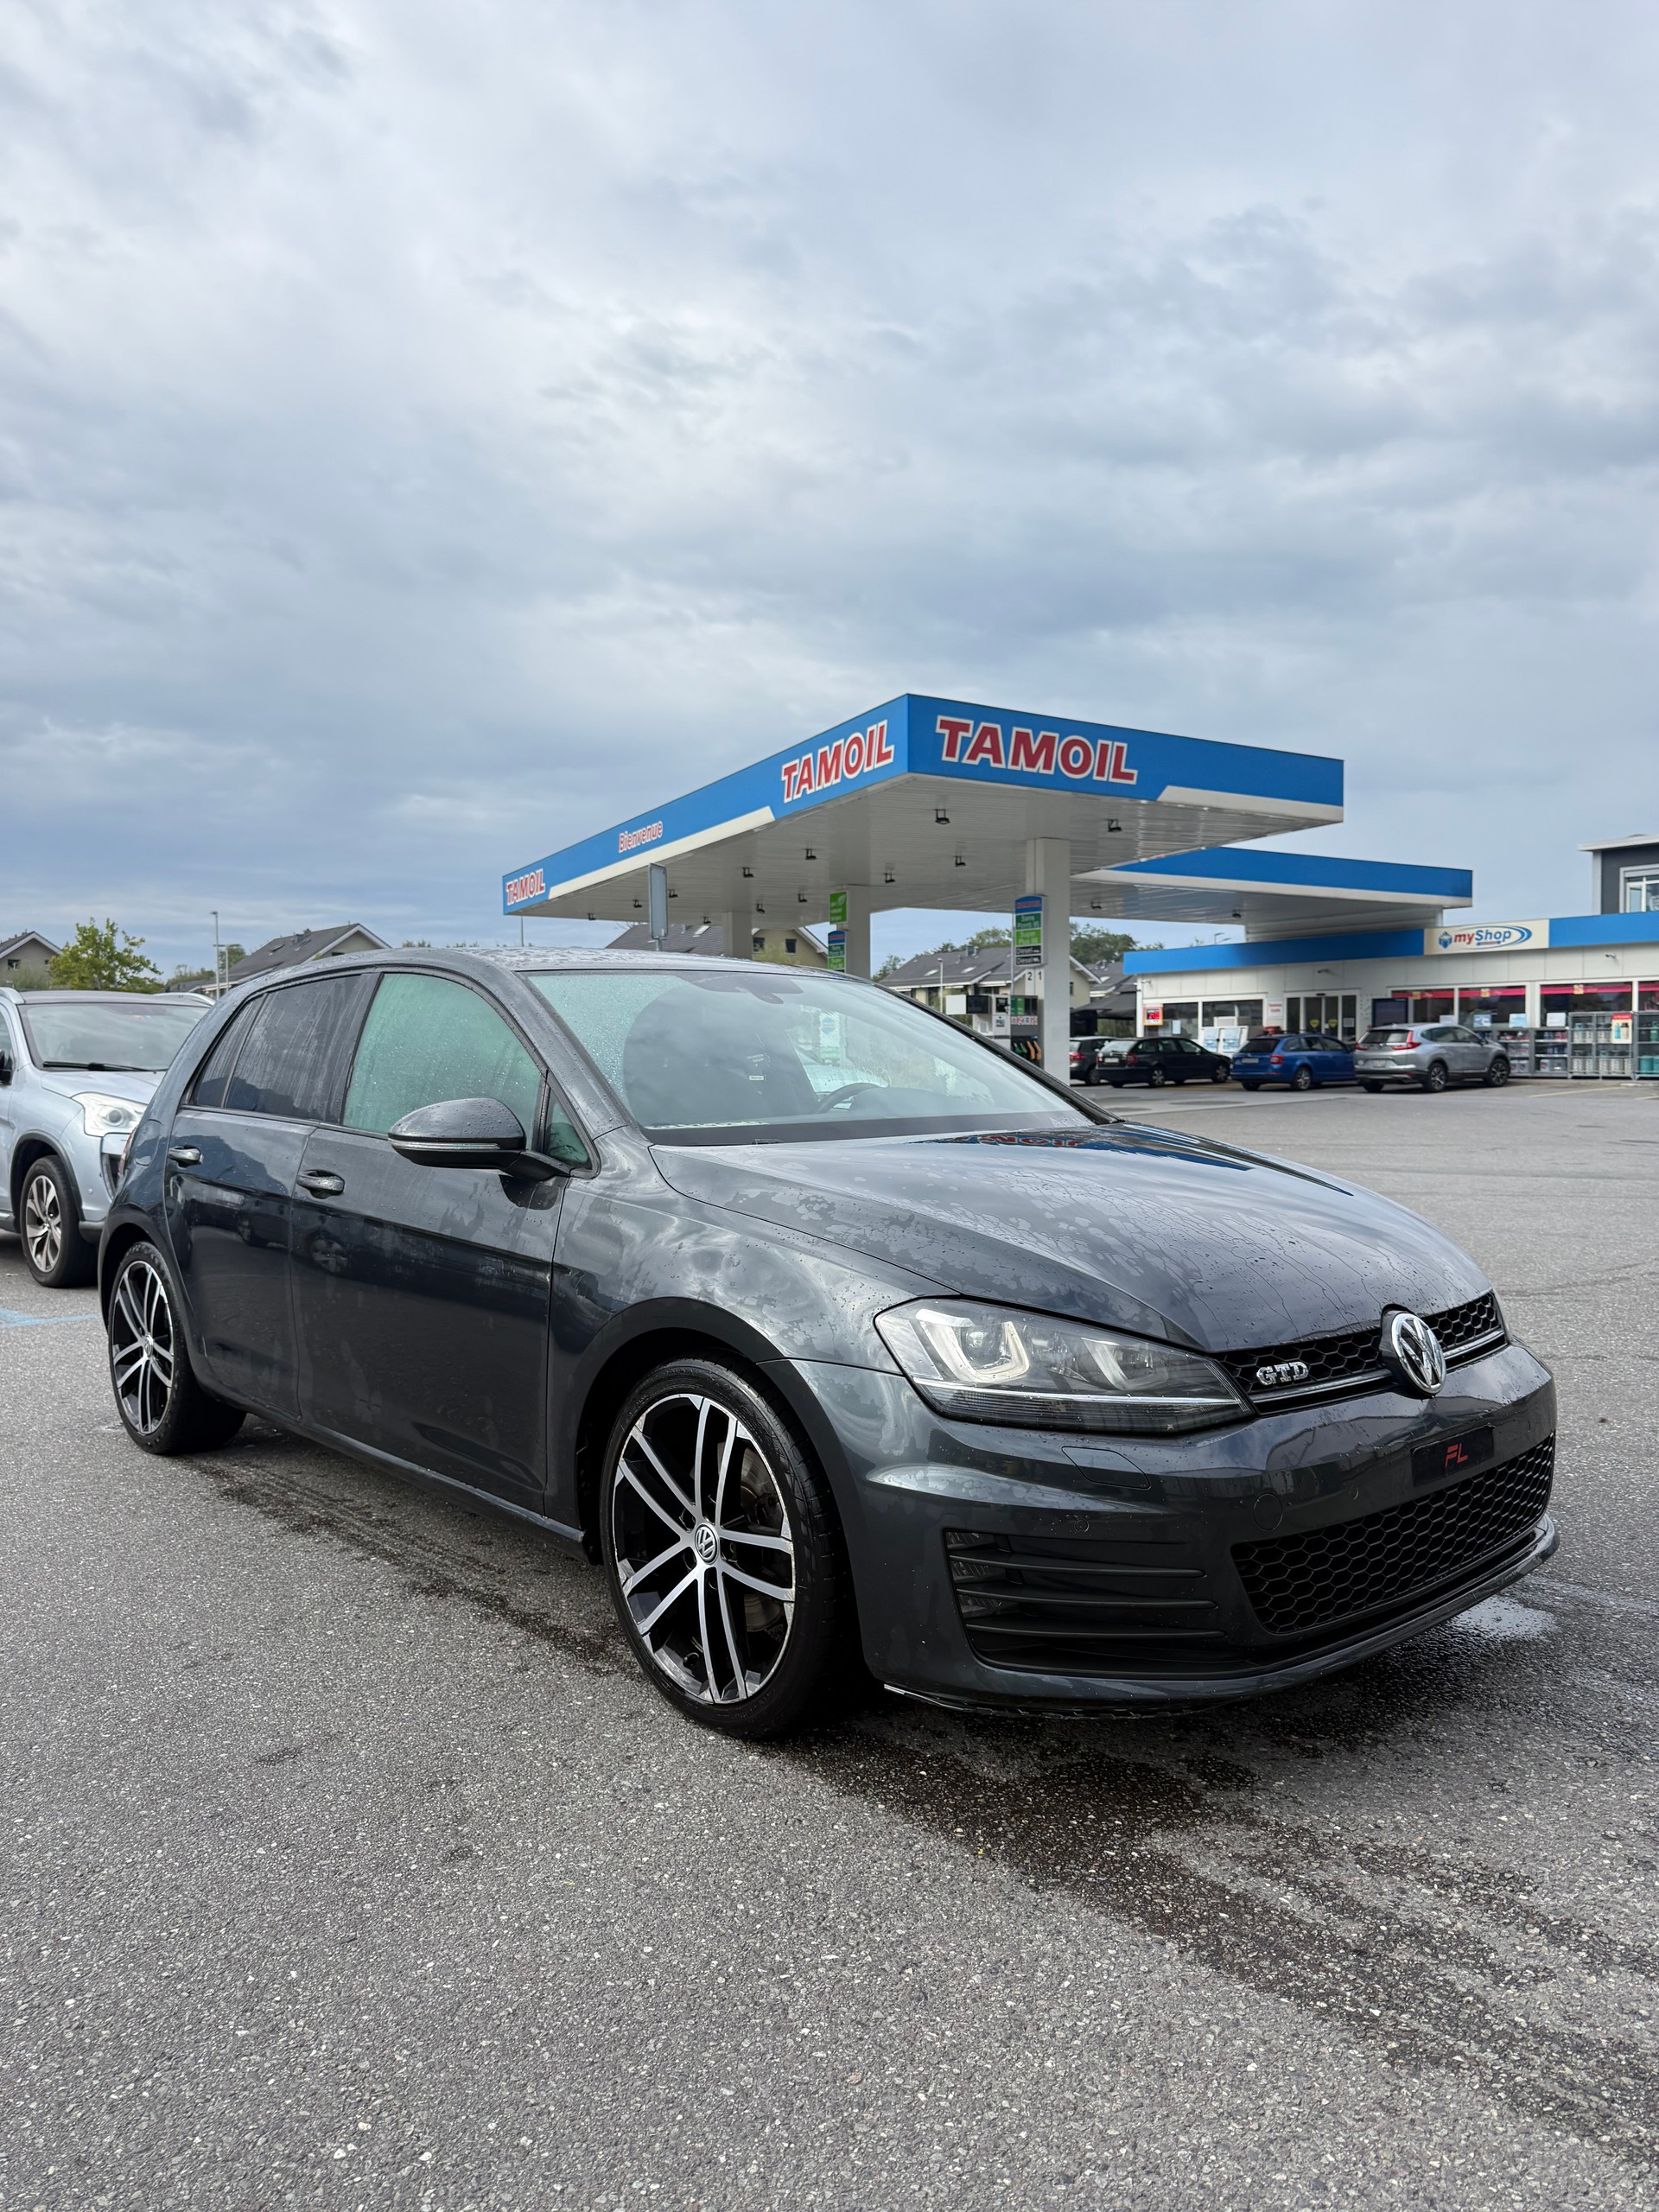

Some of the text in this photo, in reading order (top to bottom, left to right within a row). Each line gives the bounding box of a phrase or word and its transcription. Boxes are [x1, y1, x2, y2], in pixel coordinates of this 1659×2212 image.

[781, 719, 894, 803] TAMOIL
[936, 715, 1138, 785] TAMOIL
[619, 821, 663, 853] Bienvenue
[506, 868, 545, 906] TAMOIL
[1453, 930, 1511, 944] myShop
[1027, 971, 1033, 981] 2
[1038, 971, 1042, 981] 1
[1256, 1362, 1309, 1385] GTD
[1446, 1443, 1468, 1467] FL
